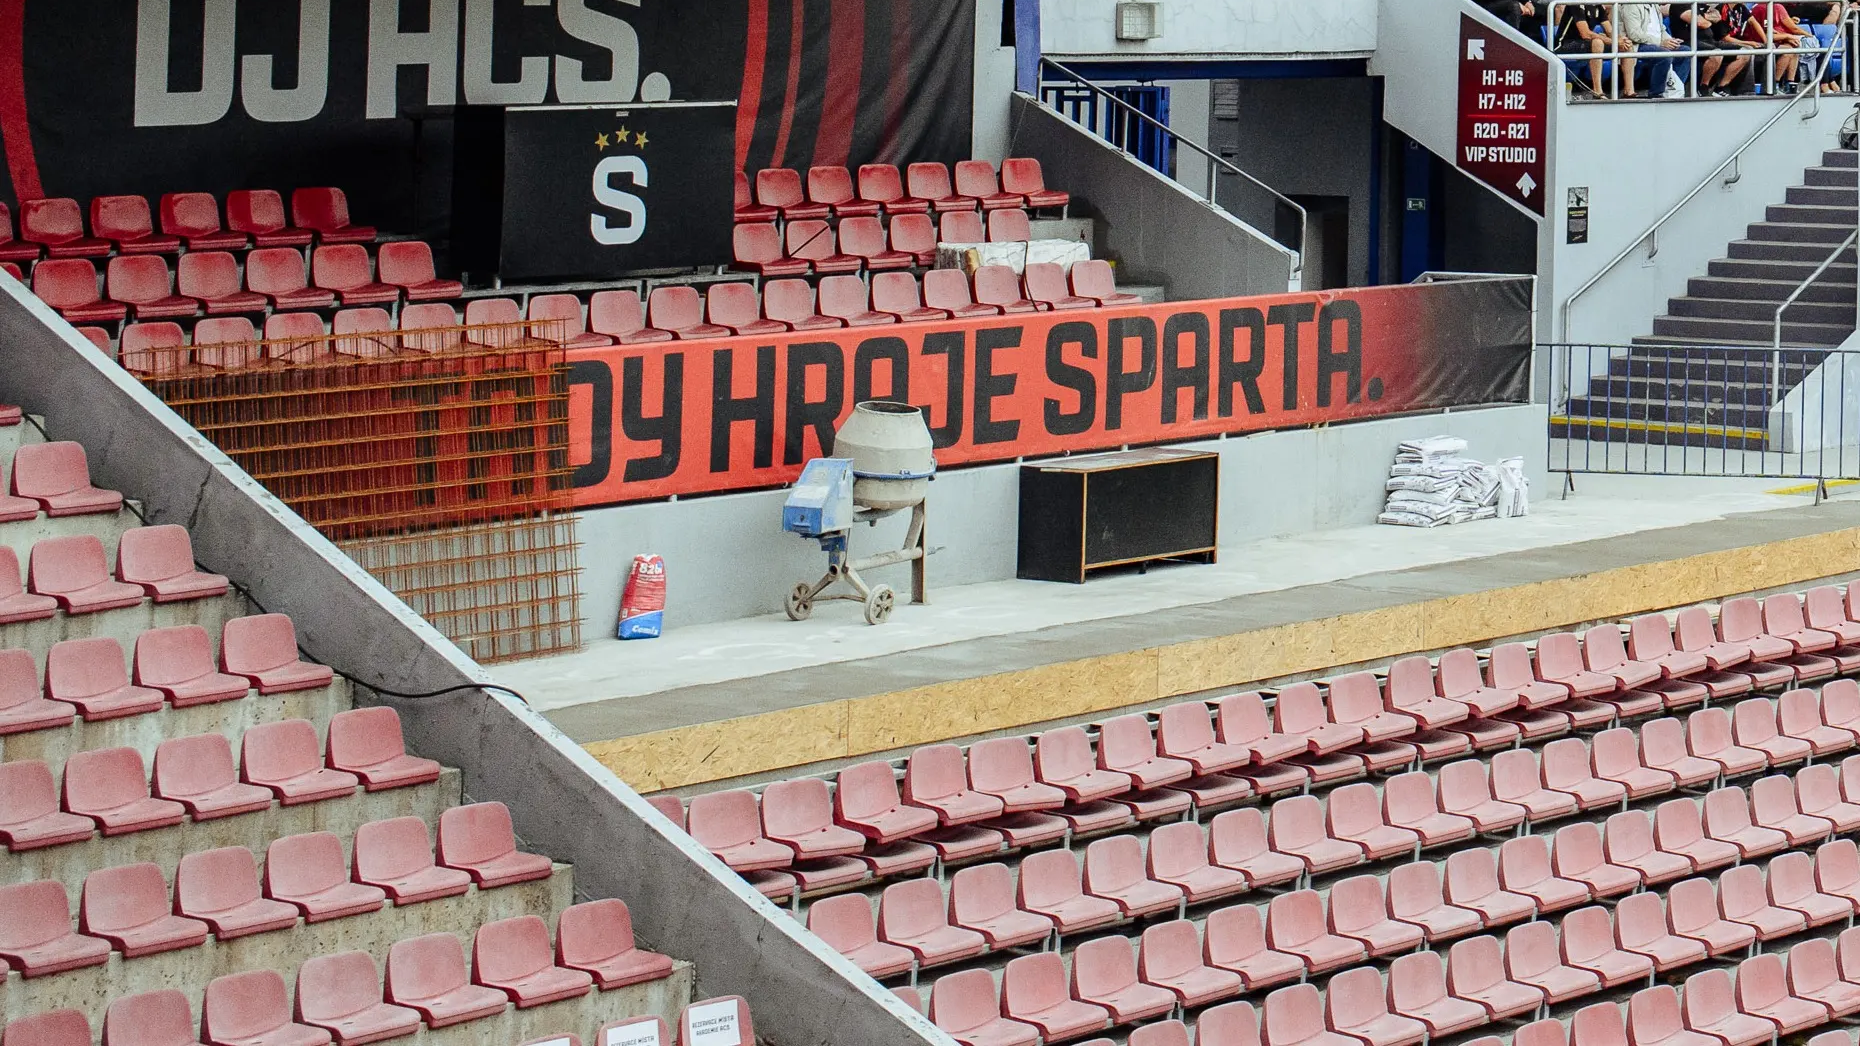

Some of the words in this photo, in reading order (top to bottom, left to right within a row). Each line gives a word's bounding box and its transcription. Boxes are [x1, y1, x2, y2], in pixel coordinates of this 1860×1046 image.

[1465, 146, 1487, 163] VIP
[1489, 147, 1537, 163] STUDIO
[590, 155, 648, 245] S
[710, 327, 1021, 473] HRAJE
[1043, 298, 1384, 436] SPARTA.
